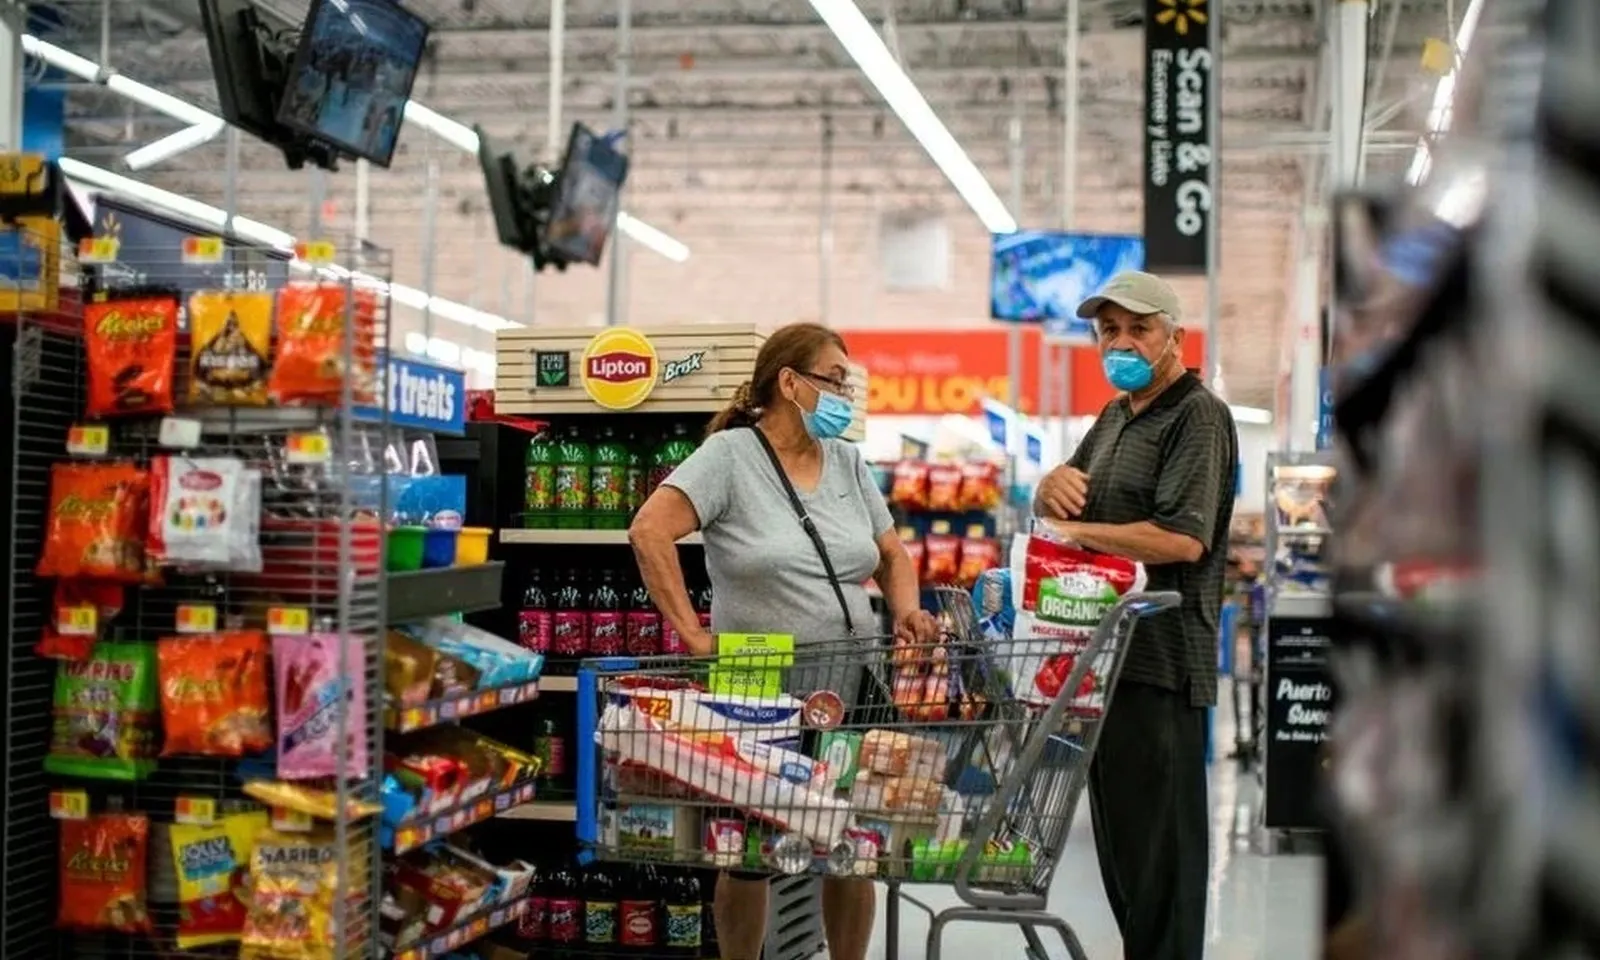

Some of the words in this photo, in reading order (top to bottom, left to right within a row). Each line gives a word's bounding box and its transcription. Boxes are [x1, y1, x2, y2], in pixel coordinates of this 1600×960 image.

[1176, 48, 1211, 134] Scan
[1176, 142, 1211, 173] &
[1176, 179, 1211, 236] Go
[592, 359, 647, 378] Lipton
[665, 353, 703, 382] Brisk
[401, 366, 455, 422] treats
[868, 376, 919, 412] OU
[1276, 678, 1332, 701] Puerto
